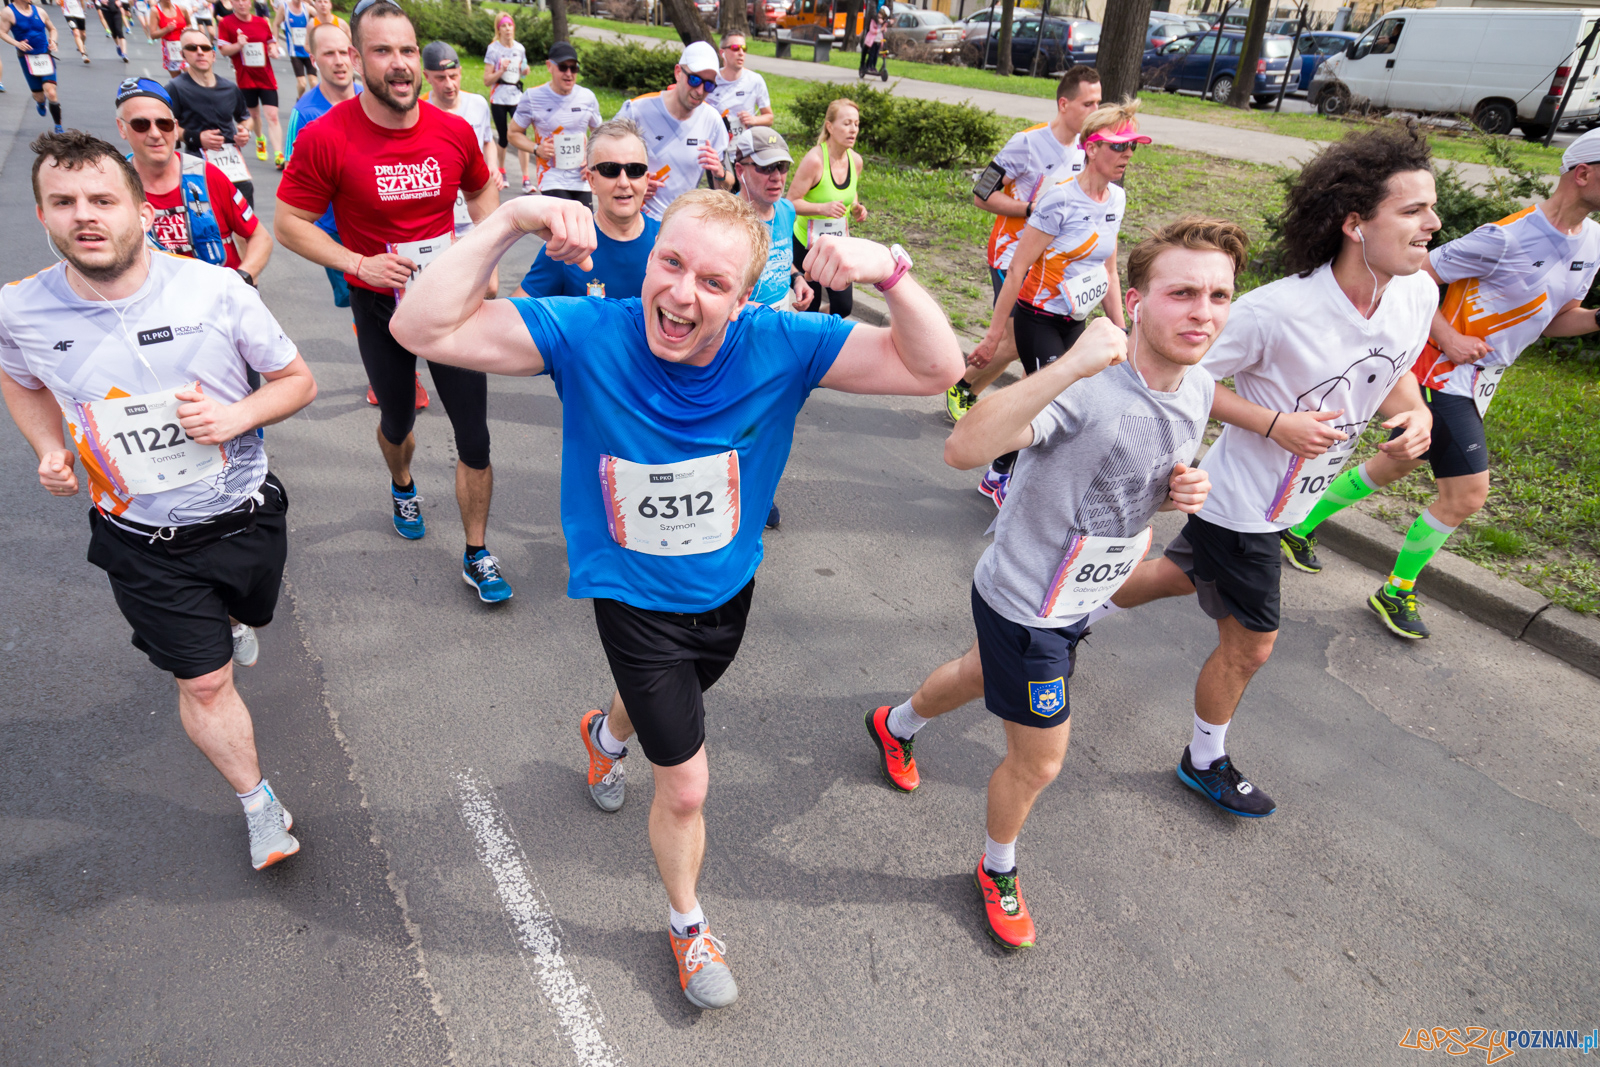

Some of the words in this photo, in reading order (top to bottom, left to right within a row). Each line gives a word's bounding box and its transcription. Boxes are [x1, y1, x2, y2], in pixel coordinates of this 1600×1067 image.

[560, 145, 581, 154] 3218
[214, 155, 241, 167] 11742
[374, 162, 430, 176] DRUŻYNA
[376, 171, 442, 193] SZPIKU
[380, 189, 441, 201] www.darszpiku.pl
[1075, 281, 1108, 307] 10082
[113, 422, 195, 455] 1122
[151, 451, 186, 464] Tomasz
[638, 491, 714, 519] 6312
[659, 522, 696, 532] Szymon
[1075, 559, 1134, 583] 8034
